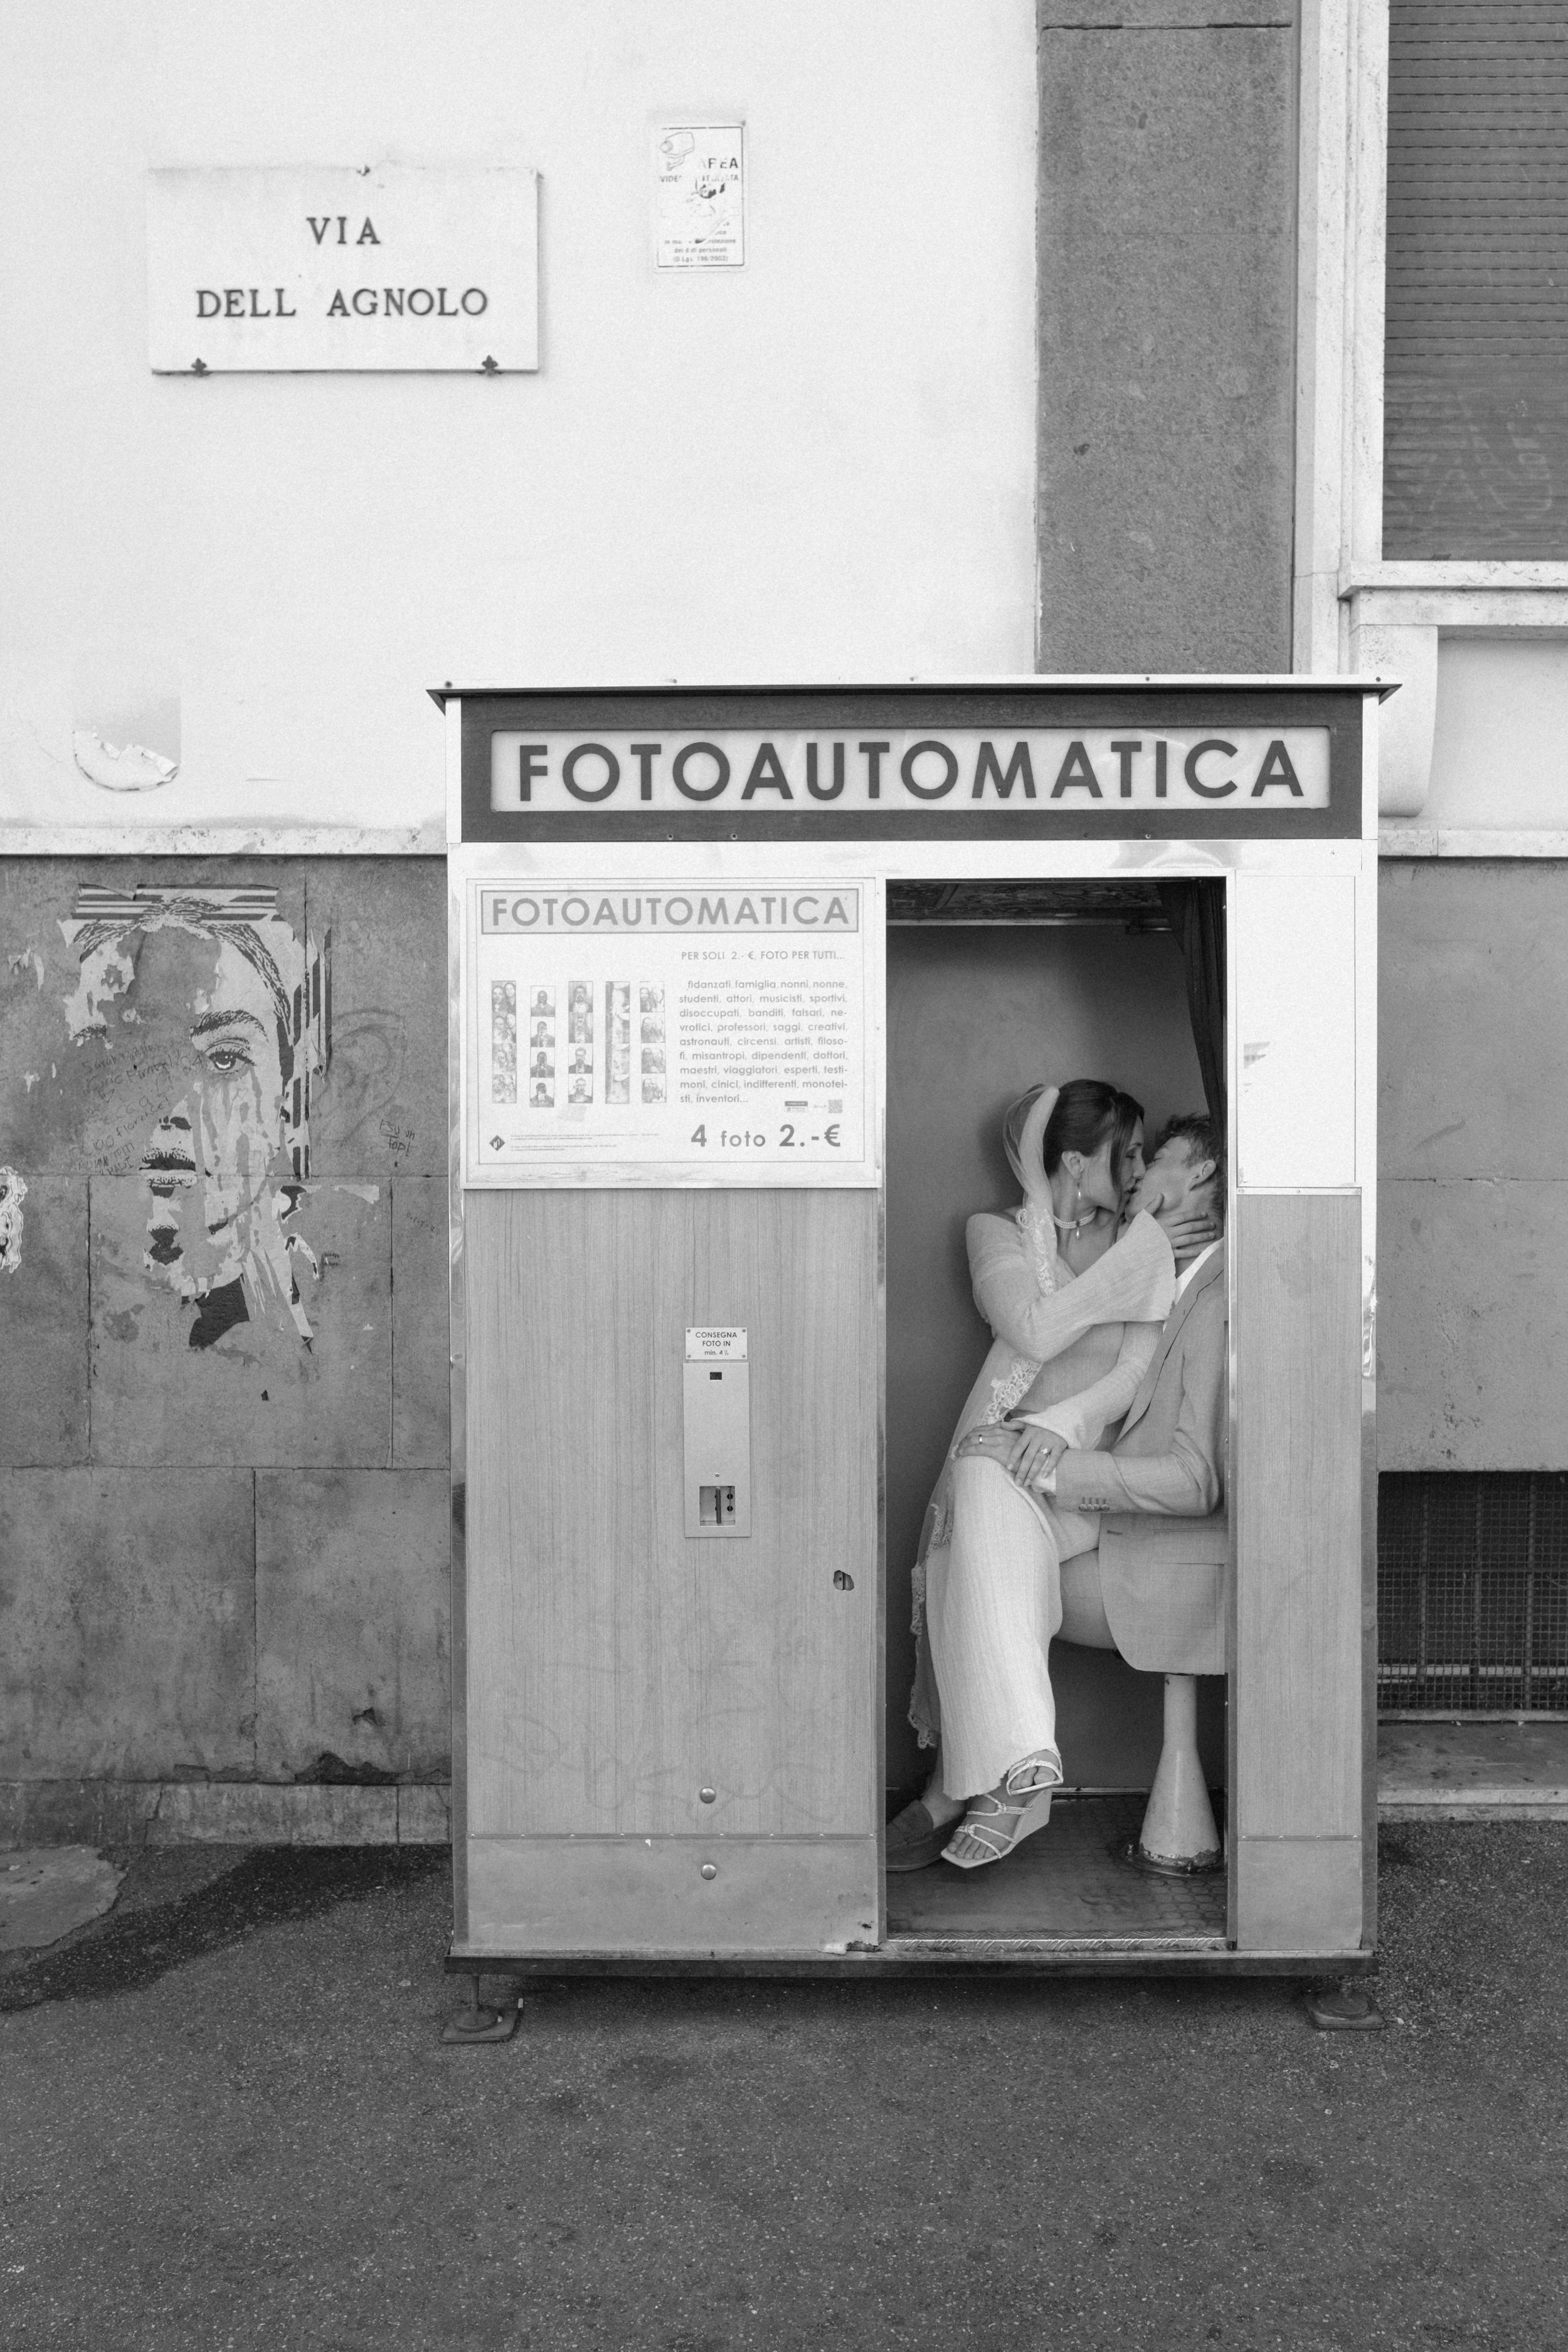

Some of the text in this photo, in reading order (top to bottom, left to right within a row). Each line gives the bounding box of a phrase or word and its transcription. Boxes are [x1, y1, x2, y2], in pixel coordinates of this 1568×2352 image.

[305, 216, 381, 245] VIA
[196, 287, 489, 319] DELL AGNOLO
[519, 739, 1304, 802] FOTOAUTOMATICA
[492, 896, 849, 926] FOTOAUTOMATICA
[681, 951, 699, 960] PER
[702, 951, 725, 960] SOLI
[760, 950, 788, 960] FOTO
[792, 950, 810, 960] PER
[812, 950, 845, 960] TUTTI...
[679, 993, 848, 1004] studenti, attori, musicisti, sportivi,
[679, 1009, 742, 1019] disoccupati,
[748, 1008, 786, 1017] banditi,
[792, 1008, 824, 1017] falsari,
[679, 1022, 848, 1033] vrotici, professori, saggi, creativi,
[679, 1036, 847, 1046] astronauti, circensi, artisti, filoso-
[679, 1051, 848, 1061] fi, misantropi, dipendenti, dottori,
[680, 1065, 847, 1076] maestri, viaggiatori, esperti, testi-
[680, 1079, 847, 1089] moni, cinici, indifferenti, monotei-
[680, 1094, 748, 1104] sti, inventori...
[691, 1124, 707, 1147] 4
[720, 1130, 766, 1148] foto
